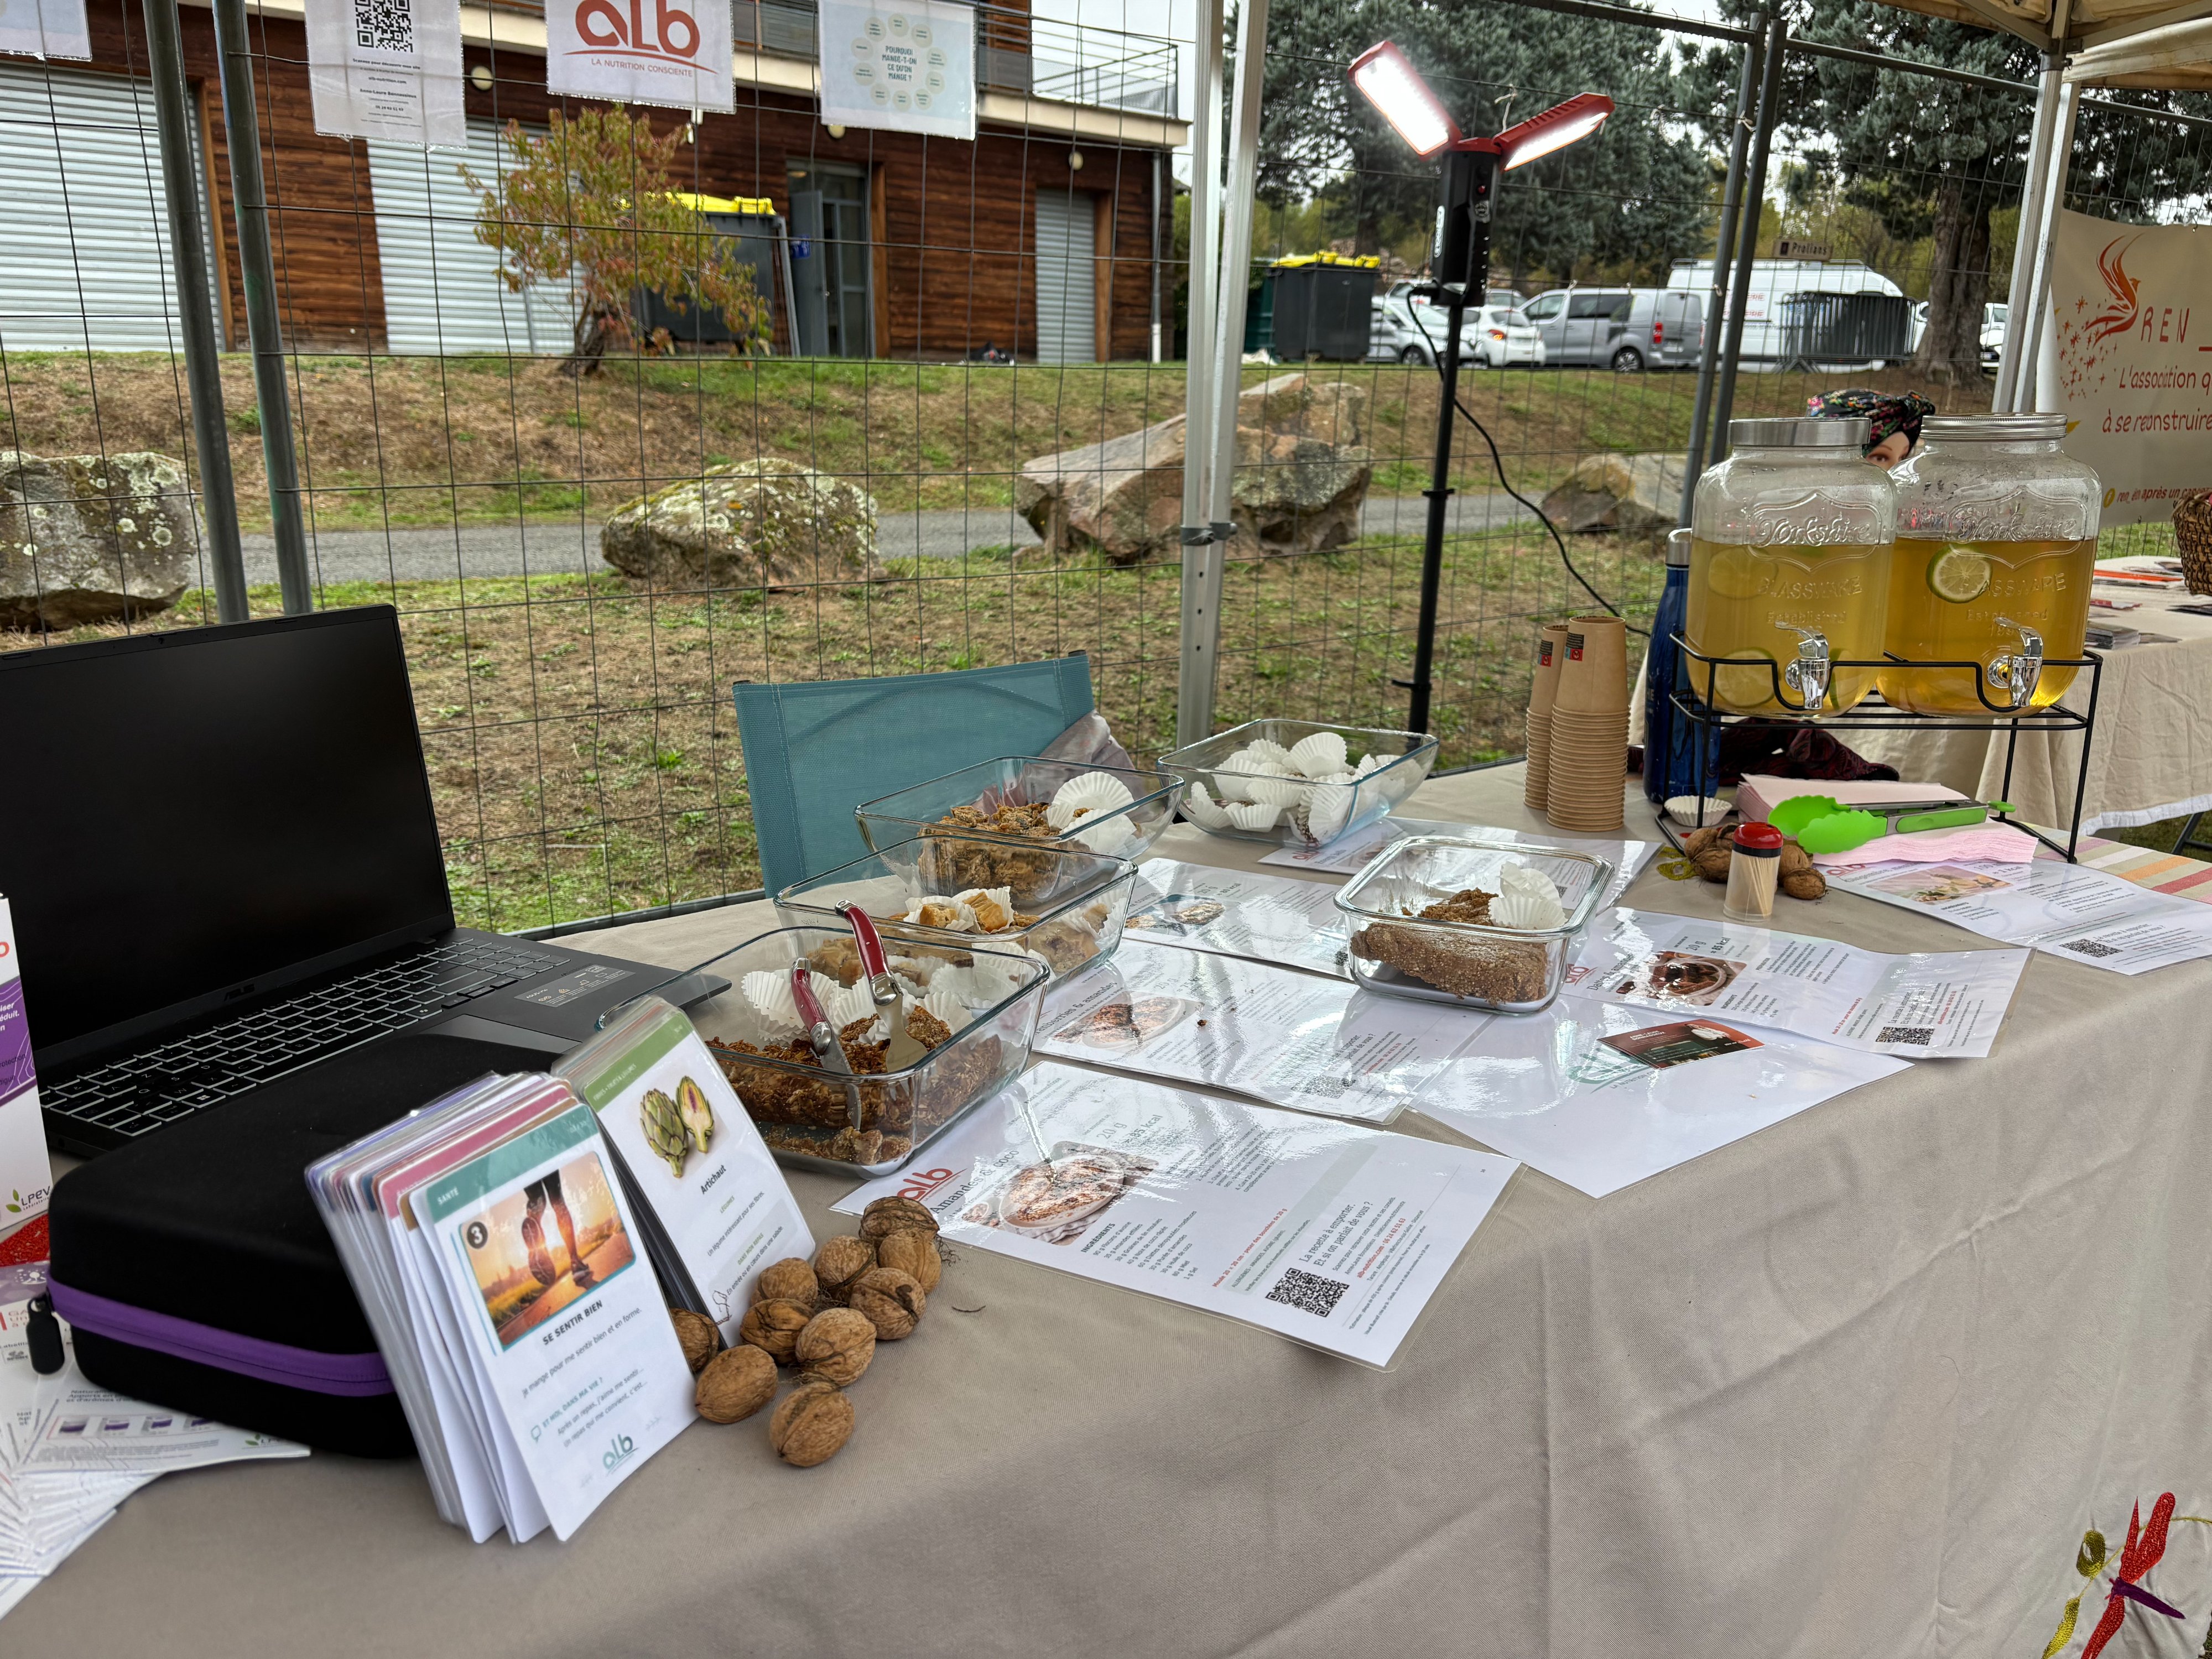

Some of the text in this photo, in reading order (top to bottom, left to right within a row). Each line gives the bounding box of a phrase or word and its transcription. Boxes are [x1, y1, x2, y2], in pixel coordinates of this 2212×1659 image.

[882, 54, 917, 65] MANGE-T-ON
[885, 45, 913, 55] POURQUOI
[604, 60, 645, 71] NUTRITION
[647, 64, 693, 77] CONSCIENTE
[888, 72, 907, 81] MANGE
[2102, 408, 2112, 433] à
[2115, 415, 2132, 433] se
[2141, 486, 2167, 502] après
[2168, 488, 2180, 499] un
[1758, 511, 1870, 547] Yorkshire
[1714, 936, 1731, 946] kcal
[1082, 982, 1117, 1003] amandes
[1152, 980, 1170, 991] 20
[1585, 975, 1612, 990] Dattes
[1342, 1047, 1361, 1060] parlait
[1361, 1035, 1374, 1044] vous
[1095, 1128, 1118, 1140] 20
[1128, 1114, 1164, 1138] 85 kcal
[699, 1163, 727, 1195] Artichaut
[927, 1149, 1022, 1214] Amandes & coco
[719, 1194, 735, 1214] LÉGUMES
[1354, 1205, 1371, 1218] vous
[706, 1248, 714, 1257] Un
[711, 1233, 727, 1253] légume
[724, 1214, 743, 1238] intéressant
[741, 1207, 751, 1219] pour
[753, 1189, 764, 1203] fibres.
[1328, 1202, 1358, 1230] emporter.
[1345, 1217, 1361, 1227] de
[469, 1223, 485, 1245] 3
[1078, 1222, 1117, 1253] INGRÉDIENTS
[1100, 1234, 1119, 1248] Flocons
[1305, 1233, 1331, 1254] recette
[1330, 1224, 1356, 1245] parlait
[736, 1232, 764, 1266] DANS MON REPAS
[1122, 1240, 1141, 1254] Graines
[1144, 1247, 1162, 1260] Dattes
[1167, 1255, 1182, 1266] Huile
[1180, 1242, 1194, 1252] coco
[1211, 1274, 1227, 1287] Moule
[1242, 1242, 1257, 1253] peser
[1257, 1219, 1277, 1237] bouchées
[1298, 1253, 1314, 1262] La
[1325, 1244, 1339, 1253] on
[726, 1286, 733, 1296] En
[730, 1274, 743, 1290] entrée
[741, 1269, 748, 1278] ou
[745, 1264, 752, 1272] en
[750, 1252, 761, 1267] cœurs
[758, 1243, 768, 1256] dans
[772, 1224, 784, 1239] salade.
[1312, 1258, 1328, 1266] Et
[1355, 1245, 1386, 1279] alb-nutrition.com
[542, 1298, 603, 1347] SE SENTIR BIEN
[527, 1303, 642, 1392] mange pour me sentir bien et en forme.
[541, 1417, 550, 1429] ET
[561, 1394, 579, 1413] DANS
[577, 1387, 589, 1400] MA
[587, 1379, 599, 1392] VIE
[598, 1375, 603, 1384] ?
[556, 1363, 644, 1437] Après un repas, j'aime me sentir...
[570, 1425, 586, 1443] repas
[584, 1418, 596, 1431] qui
[594, 1410, 605, 1422] me
[603, 1390, 629, 1416] convient,
[628, 1376, 648, 1396] c'est...
